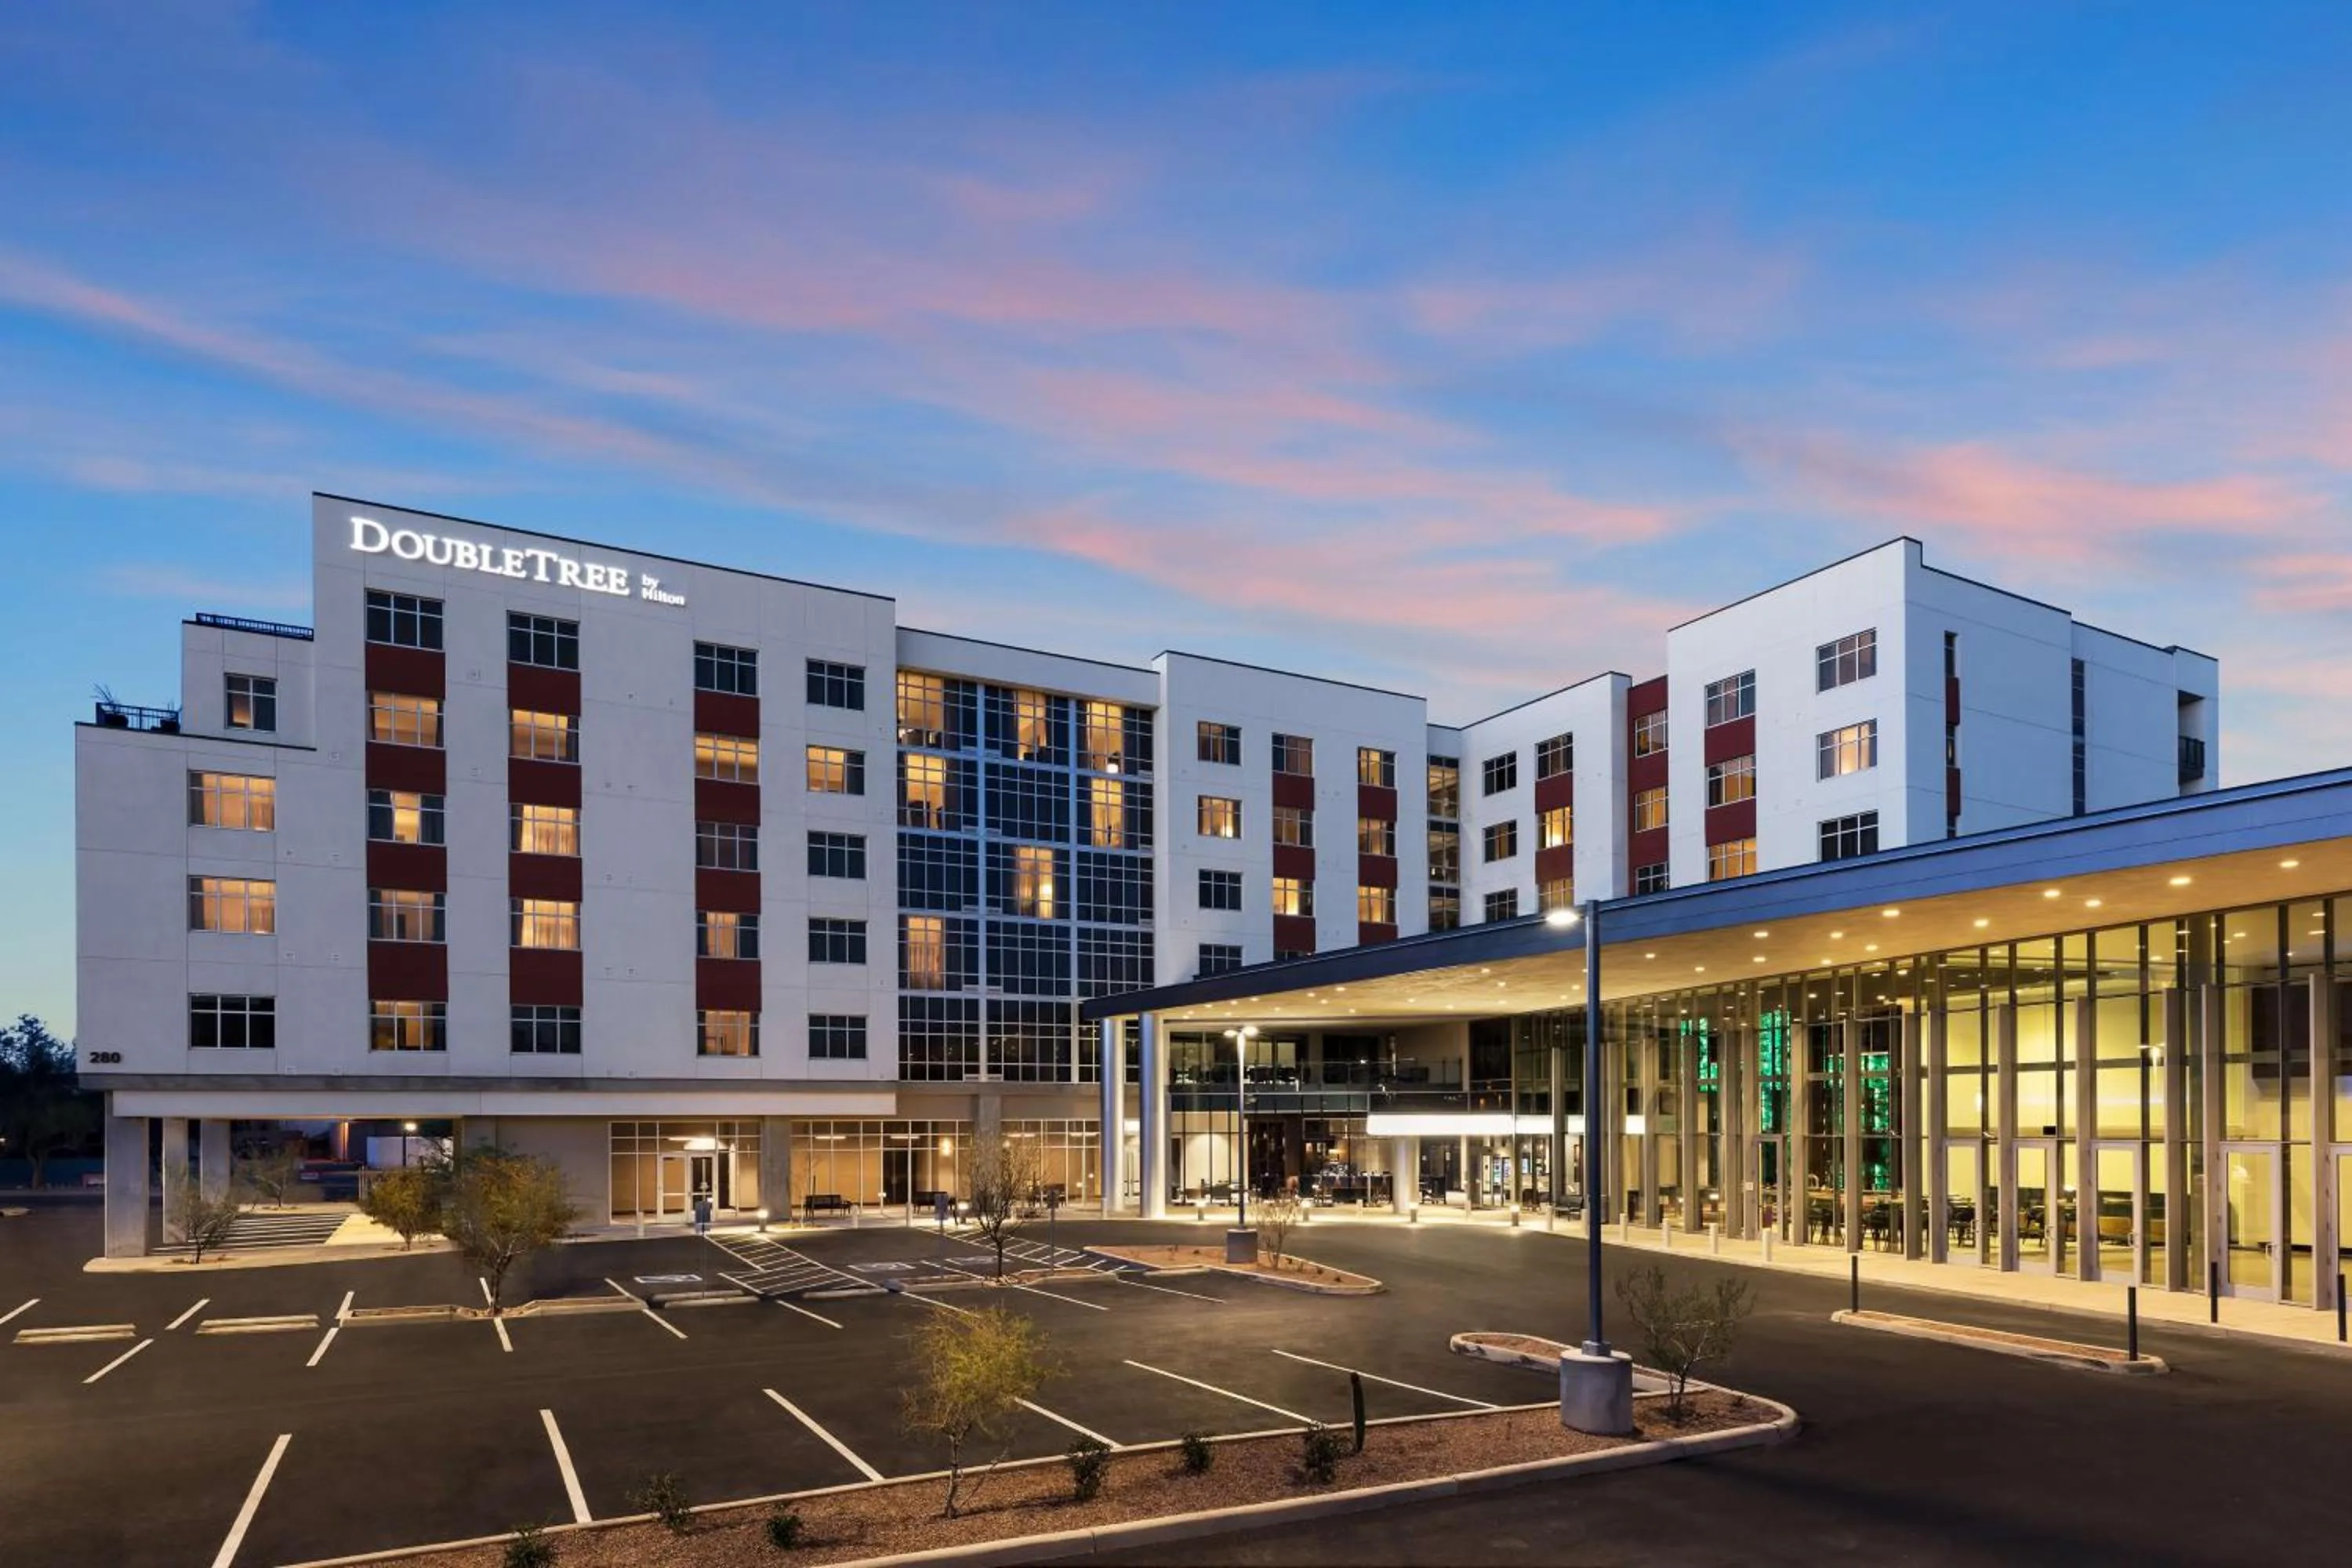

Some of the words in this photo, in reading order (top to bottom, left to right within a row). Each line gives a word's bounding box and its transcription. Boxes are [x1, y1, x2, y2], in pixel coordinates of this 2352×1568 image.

[641, 573, 659, 590] by
[641, 588, 685, 605] Hilton
[89, 1051, 122, 1064] 280
